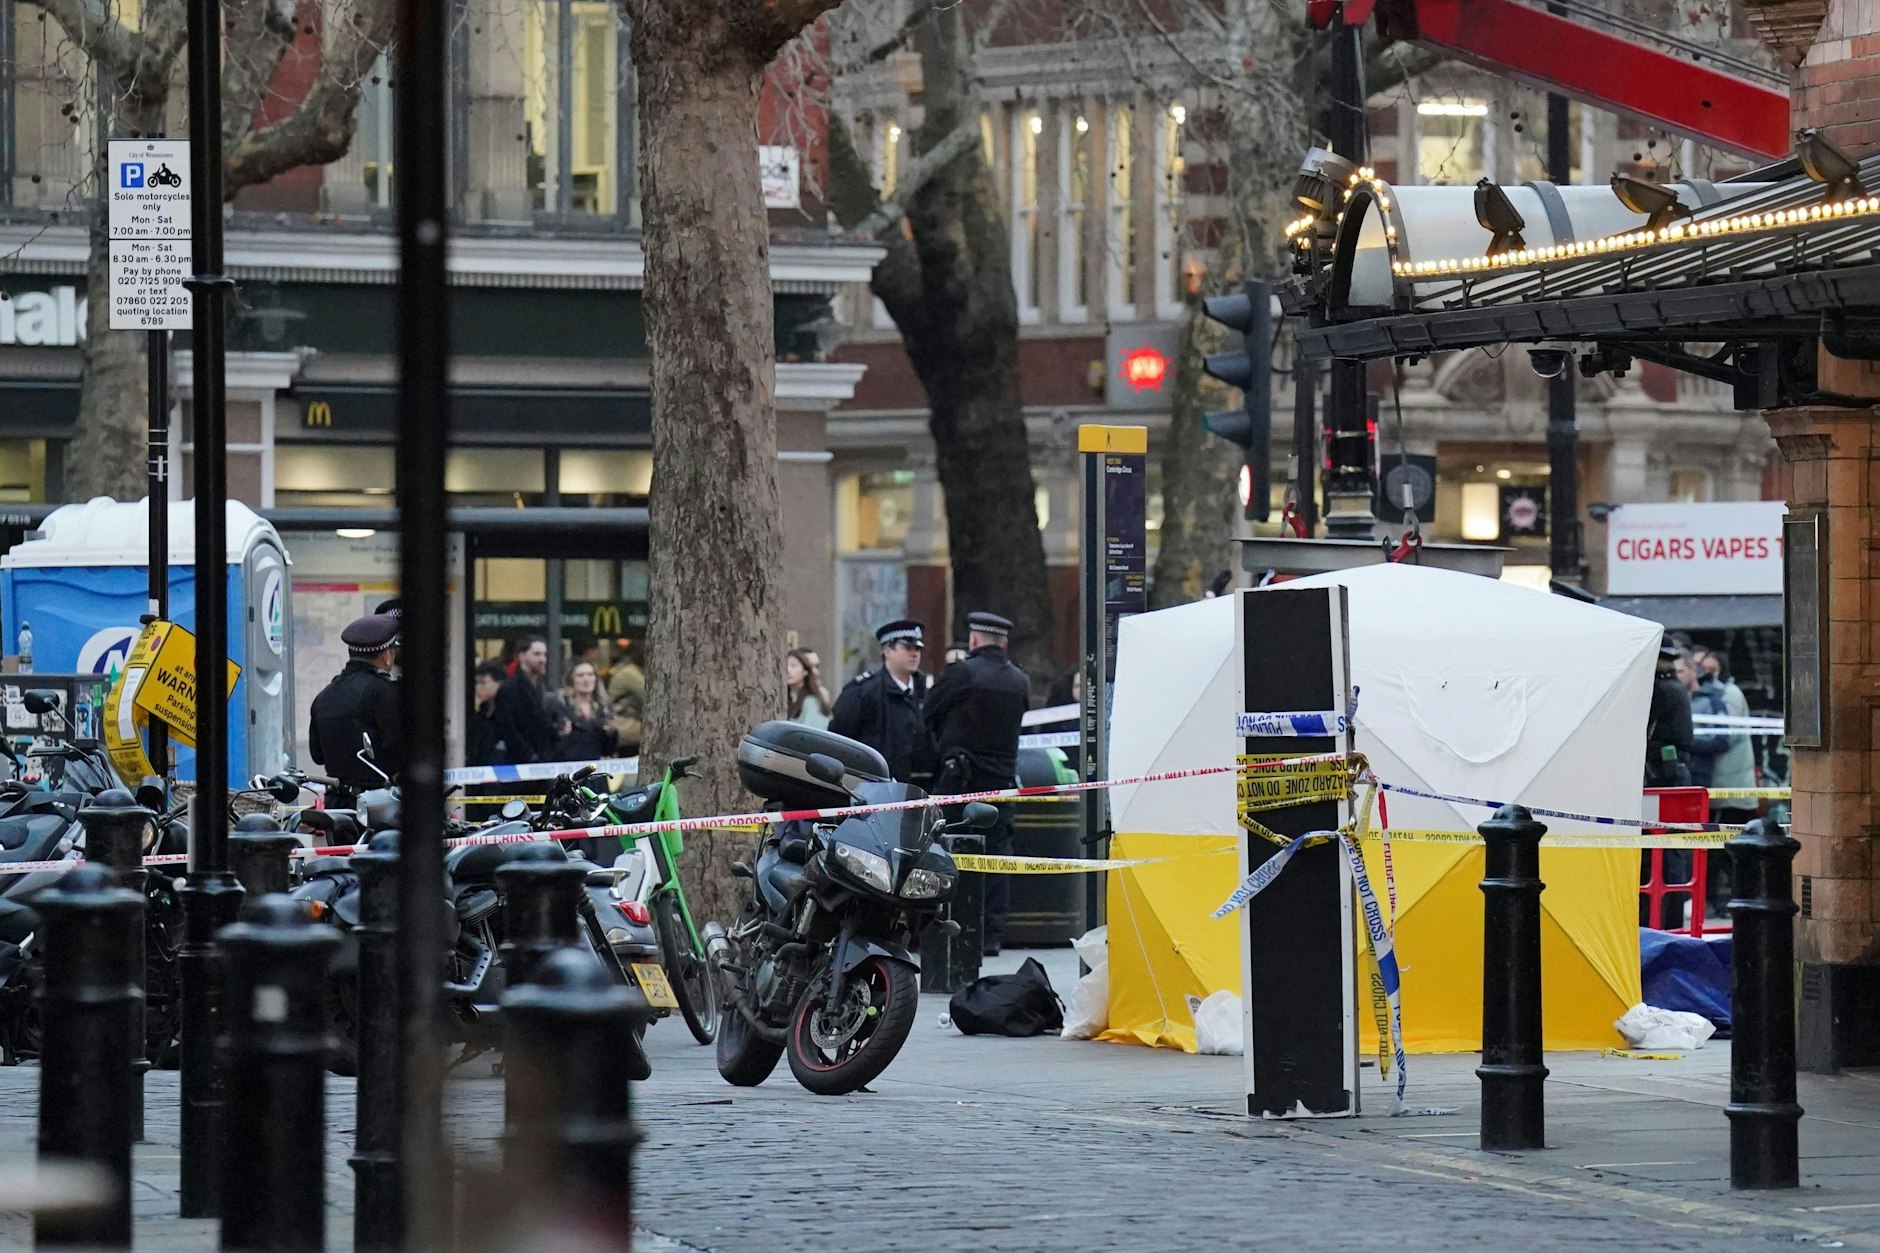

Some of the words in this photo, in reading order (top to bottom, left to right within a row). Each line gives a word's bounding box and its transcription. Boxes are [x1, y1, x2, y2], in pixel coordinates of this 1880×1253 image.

[126, 165, 141, 186] P
[114, 192, 134, 200] Solo
[137, 193, 190, 201] motorcycles
[143, 203, 161, 211] only
[131, 215, 150, 224] Mon
[157, 215, 173, 224] Sat
[113, 227, 134, 235] 7.00
[155, 227, 176, 235] 7.00
[131, 243, 150, 252] Mon
[157, 243, 173, 252] Sat
[113, 255, 134, 263] 8.30
[155, 255, 176, 263] 6.30
[123, 267, 139, 276] Pay
[142, 267, 152, 276] by
[155, 267, 182, 276] phone
[117, 277, 136, 285] 020
[139, 277, 160, 285] 7125
[150, 287, 167, 295] text
[116, 297, 146, 305] 07860
[149, 297, 167, 305] 022
[170, 297, 189, 305] 205
[117, 307, 150, 316] quoting
[152, 307, 188, 315] location
[141, 317, 164, 325] 6789
[1617, 538, 1695, 560] CIGARS
[1702, 537, 1768, 560] VAPES
[174, 665, 184, 676] at
[184, 670, 196, 685] any
[166, 694, 196, 720] Parking
[1246, 782, 1265, 798] NOT
[1267, 780, 1280, 796] DO
[1285, 777, 1310, 796] ZONE
[1312, 775, 1349, 792] HAZARD
[603, 823, 646, 837] POLICE
[650, 821, 676, 834] LINE
[680, 821, 698, 831] DO
[700, 818, 724, 830] NOT
[961, 857, 976, 869] ZONE
[977, 858, 987, 869] DO
[987, 858, 999, 870] NOT
[999, 859, 1018, 871] CROSS
[1351, 857, 1365, 874] DO
[1357, 875, 1374, 899] NOT
[1364, 901, 1387, 942] CROSS
